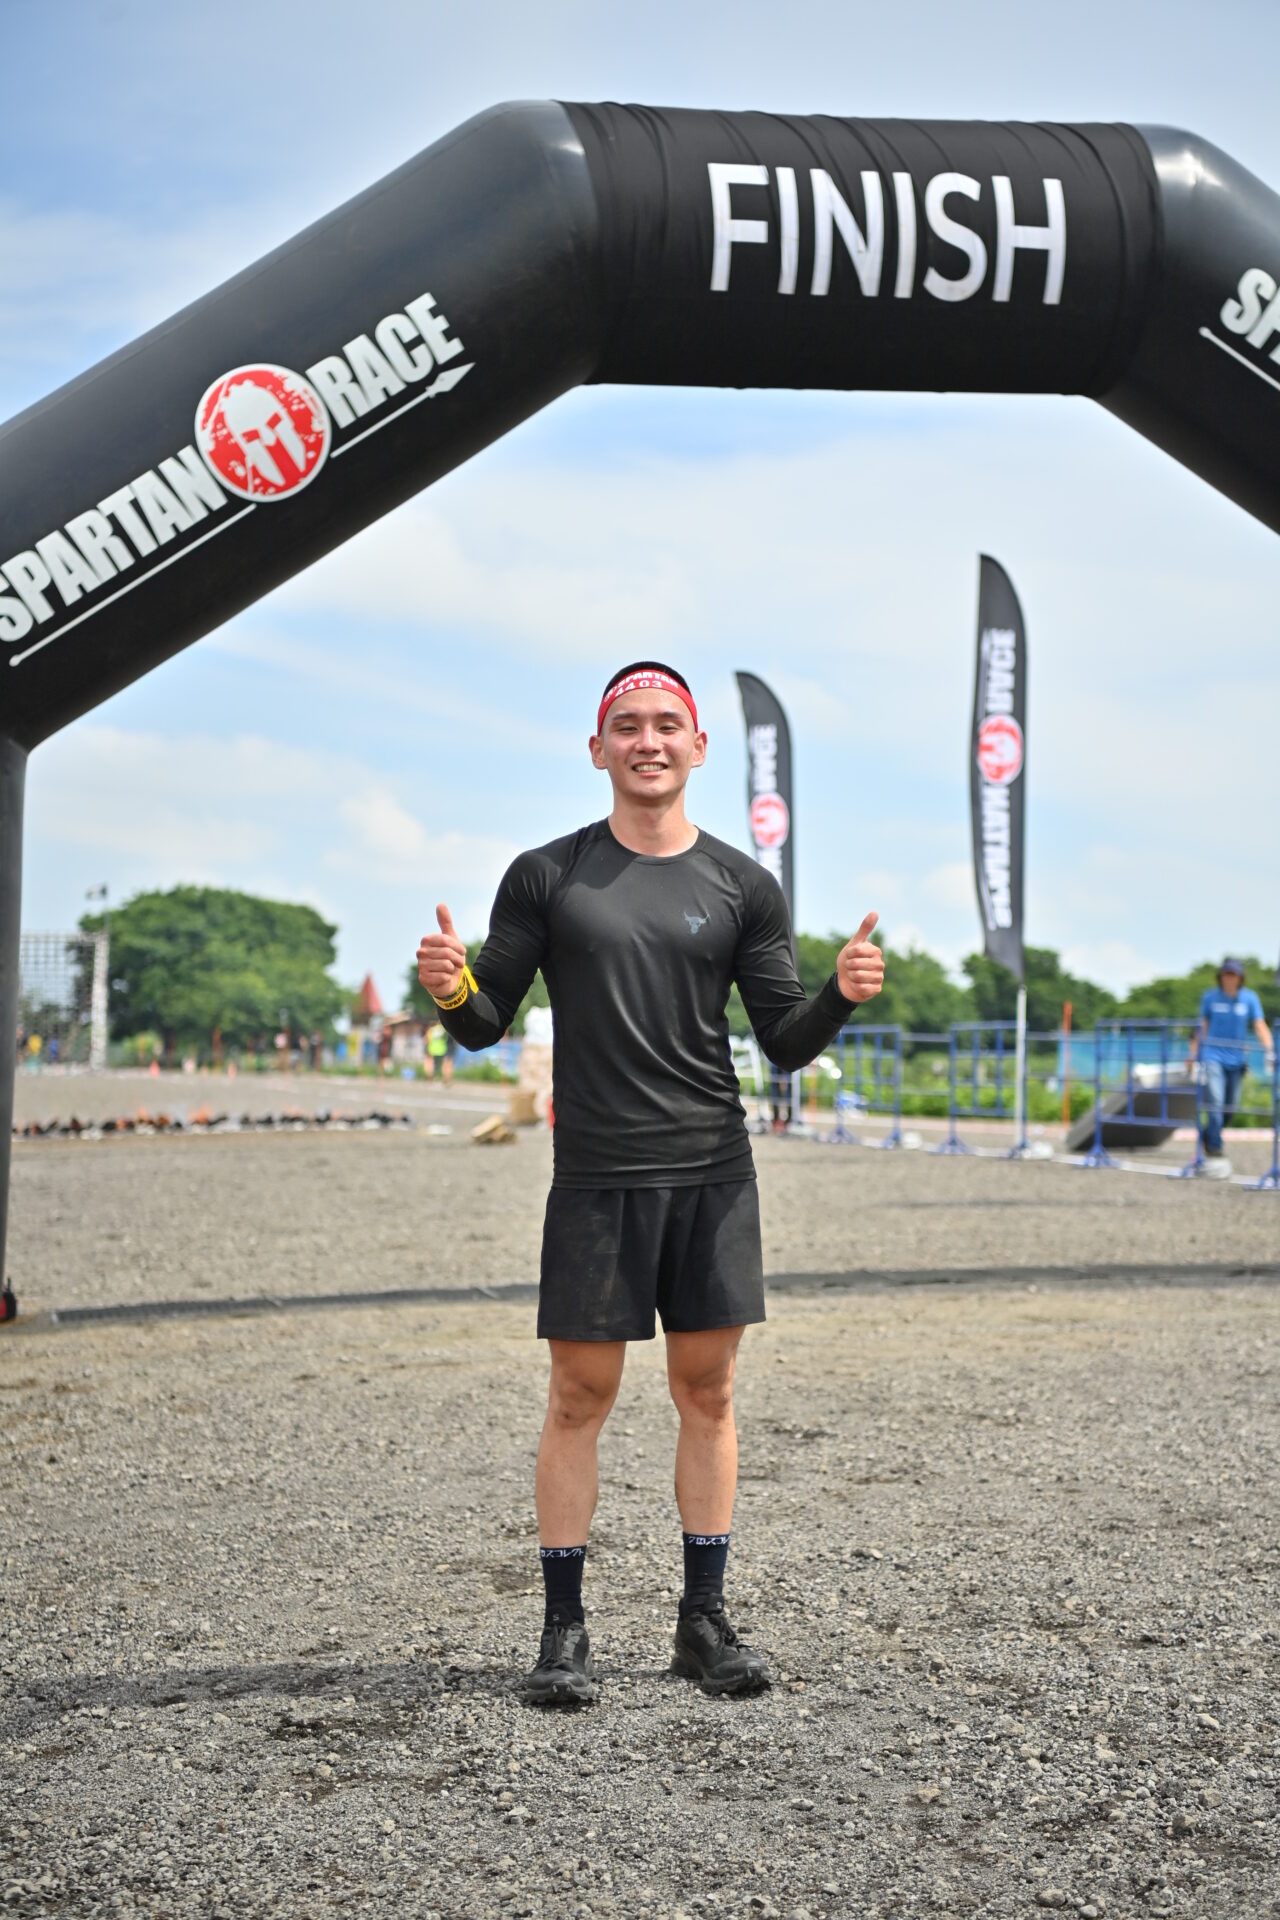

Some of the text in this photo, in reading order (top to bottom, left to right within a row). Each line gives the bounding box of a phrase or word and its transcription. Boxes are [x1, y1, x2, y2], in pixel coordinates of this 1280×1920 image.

[707, 163, 1067, 305] FINISH
[0, 292, 465, 642] SPARTAN RACE
